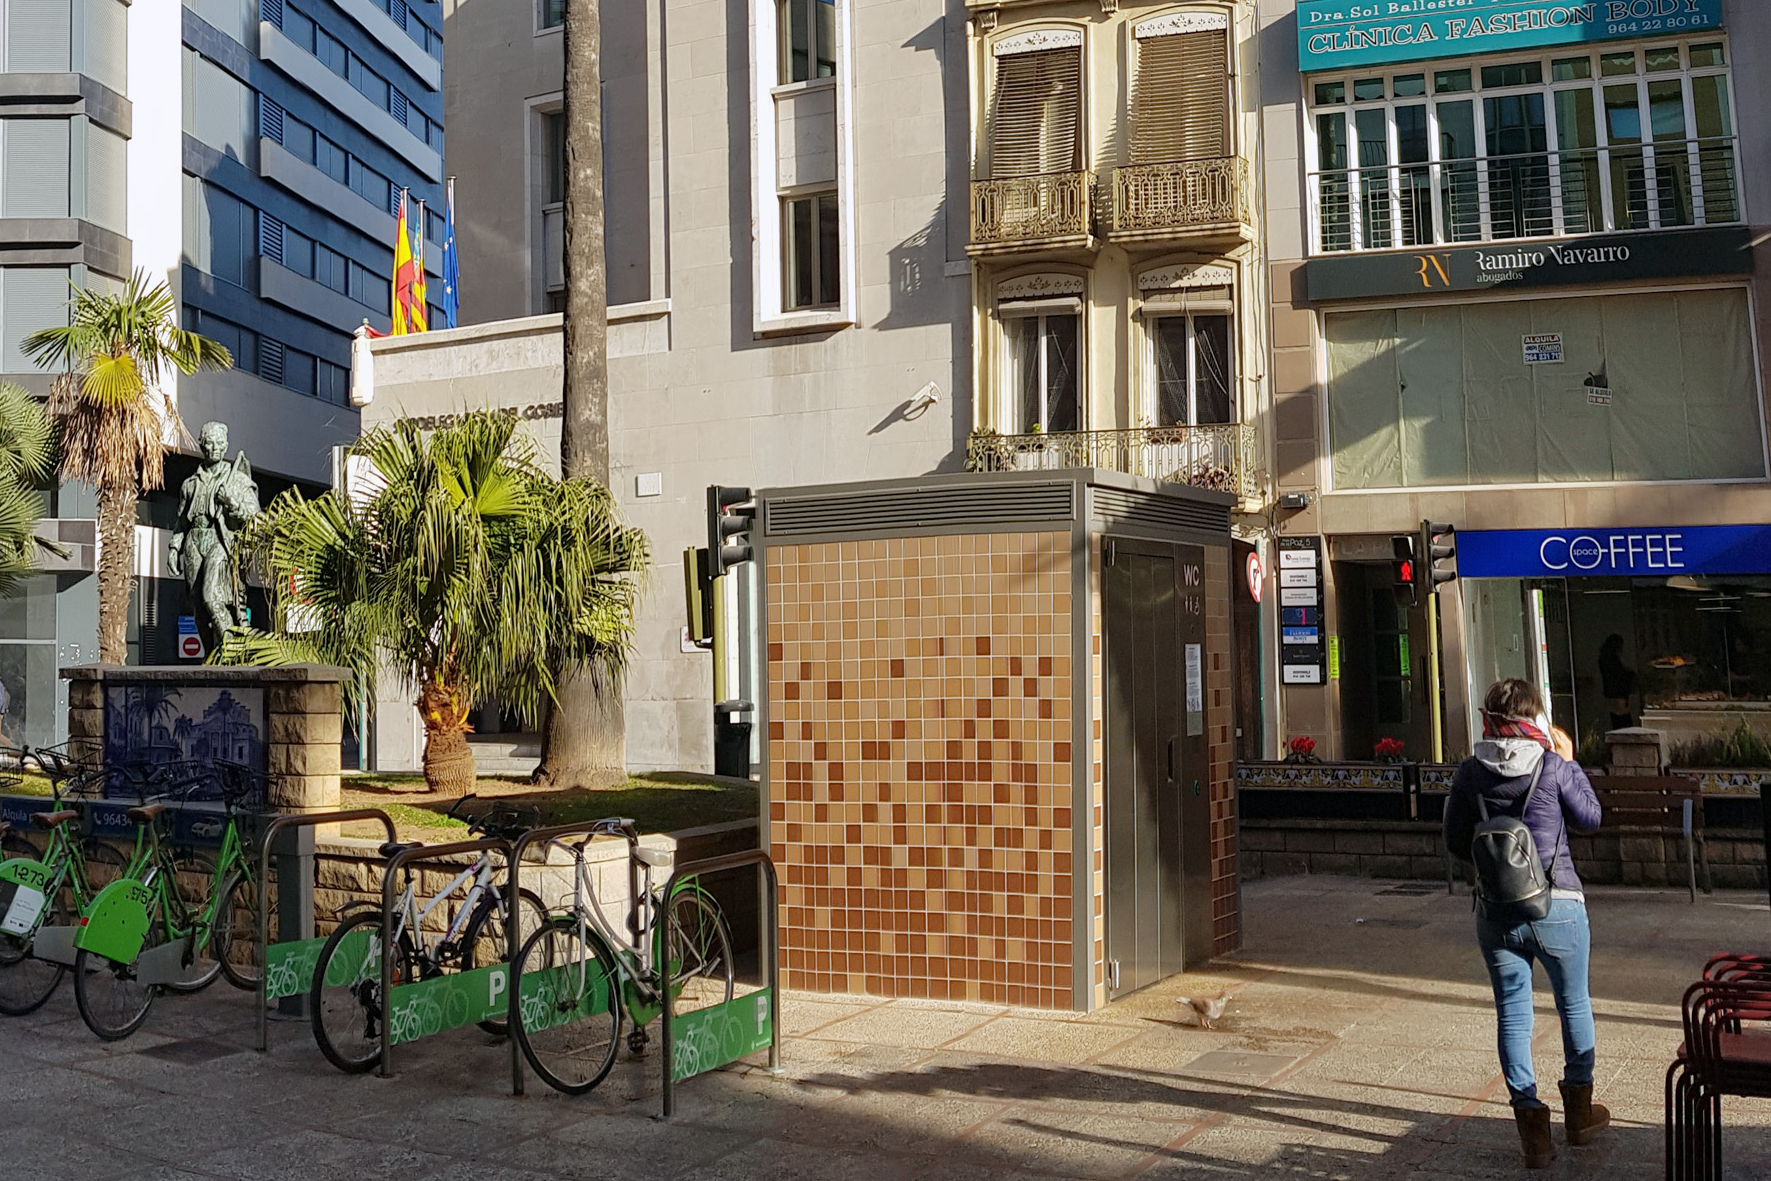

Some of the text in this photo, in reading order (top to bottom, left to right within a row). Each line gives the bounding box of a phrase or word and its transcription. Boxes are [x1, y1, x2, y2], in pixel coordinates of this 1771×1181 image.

[1308, 22, 1438, 54] CLÍNICA
[1445, 3, 1596, 40] FASHION
[1607, 14, 1709, 34] 964 22 80 61
[1475, 248, 1545, 271] Ramiro
[1547, 245, 1631, 265] Navarro
[1476, 270, 1523, 284] abogados
[1525, 335, 1559, 343] ALQUILA
[1184, 564, 1200, 587] WC
[489, 970, 506, 1007] P
